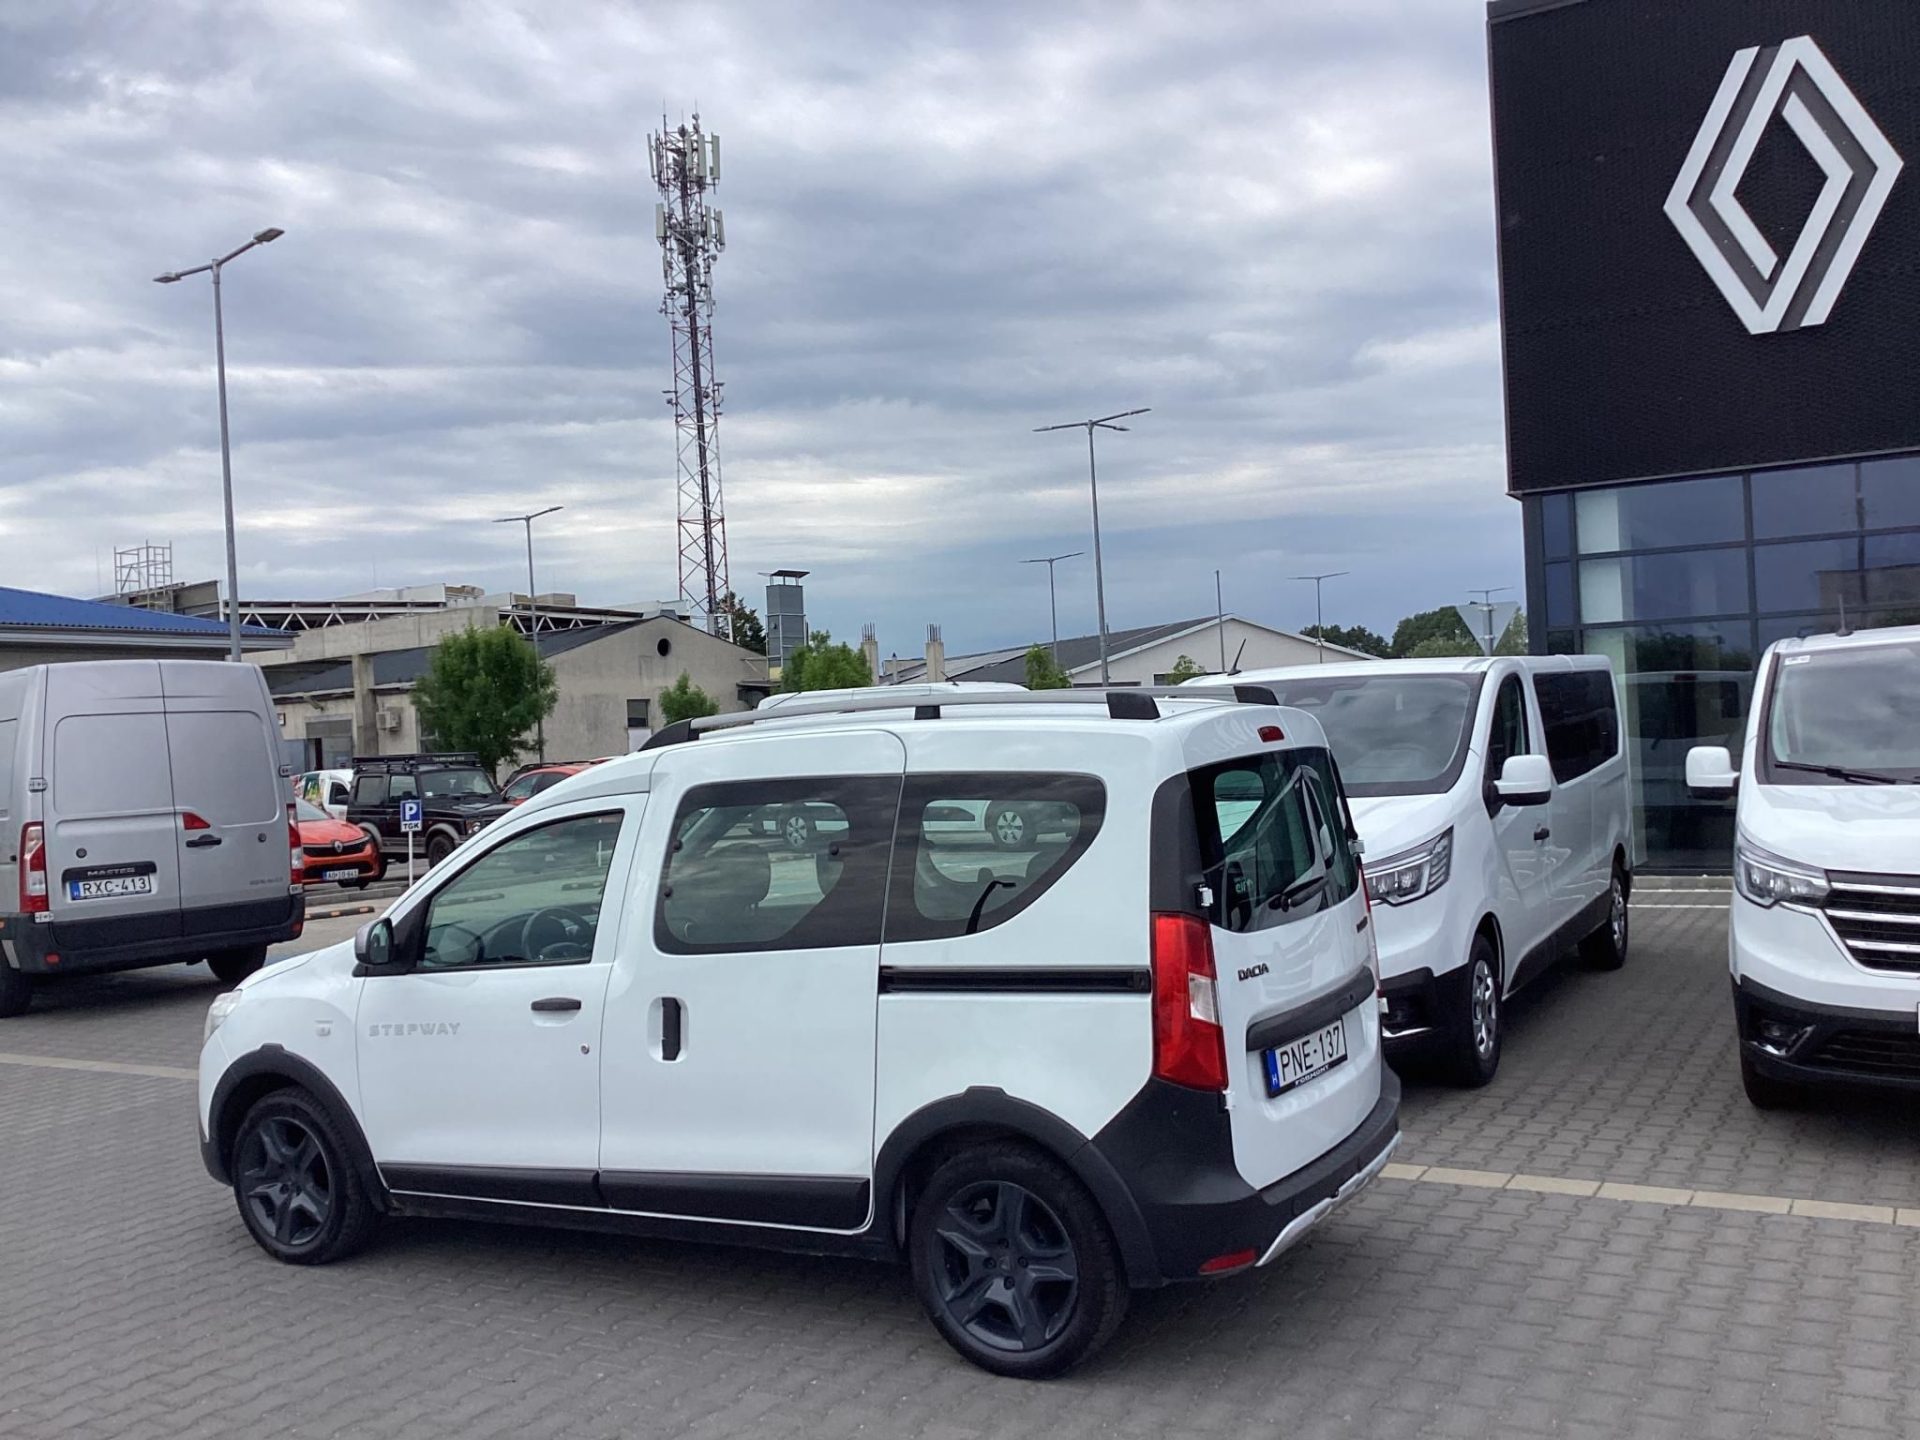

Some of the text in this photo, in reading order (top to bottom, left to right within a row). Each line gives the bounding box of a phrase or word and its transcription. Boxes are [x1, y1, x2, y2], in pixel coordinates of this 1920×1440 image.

[405, 803, 417, 820] P
[87, 867, 135, 876] MASTER
[82, 877, 147, 895] RXC-413
[1238, 963, 1269, 981] DACIA
[368, 1022, 461, 1037] STEPWAY
[1280, 1025, 1340, 1082] PNE-137
